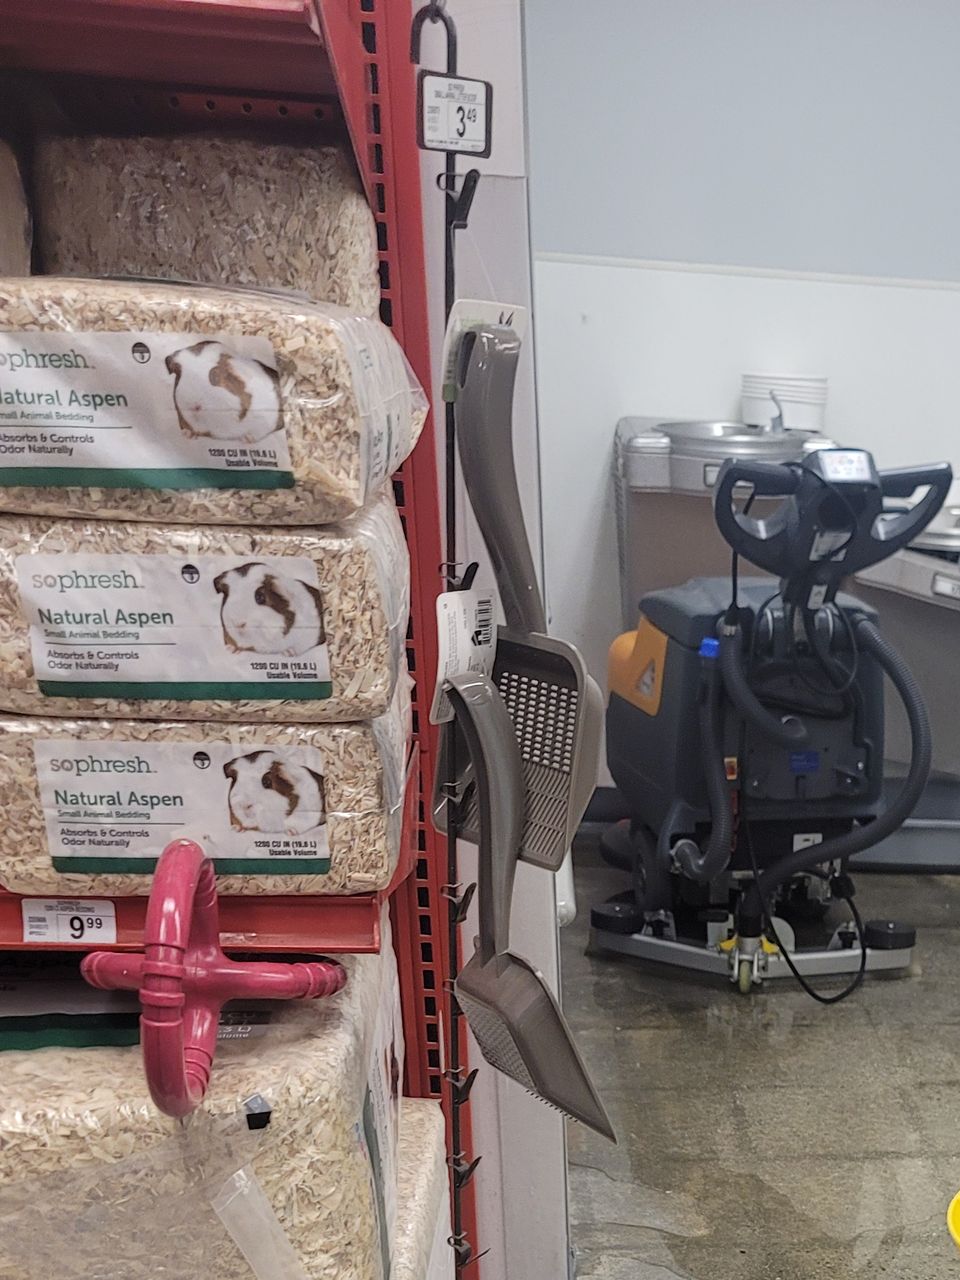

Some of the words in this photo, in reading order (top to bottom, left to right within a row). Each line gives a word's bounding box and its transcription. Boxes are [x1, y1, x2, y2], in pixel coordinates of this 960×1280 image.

[0, 349, 89, 372] ophresh
[0, 389, 63, 406] atural
[68, 389, 129, 411] Aspen
[0, 411, 18, 419] mall
[20, 411, 53, 420] Animal
[55, 412, 95, 423] Bedding
[0, 433, 38, 442] bsorbs
[40, 433, 47, 442] &
[49, 434, 95, 443] Controls
[0, 445, 26, 454] Odor
[28, 445, 74, 456] Naturally
[32, 570, 138, 593] sophresh
[37, 608, 110, 625] Natural
[115, 608, 175, 628] Aspen
[44, 629, 67, 639] Small
[68, 631, 101, 639] Animal
[102, 631, 140, 640] Bedding
[47, 650, 85, 660] Absorbs
[87, 651, 95, 660] &
[96, 651, 140, 660] Controls
[47, 660, 73, 670] Odor
[75, 661, 119, 672] Naturally
[269, 662, 280, 671] CU
[266, 671, 291, 680] Usable
[292, 672, 318, 680] Volume
[50, 755, 151, 776] sophresh
[54, 790, 122, 806] Natural
[127, 791, 184, 809] Aspen
[57, 809, 82, 818] Small
[83, 810, 113, 819] Animal
[115, 811, 151, 820] Bedding
[60, 828, 98, 837] Absorbs
[100, 828, 107, 837] &
[109, 829, 150, 838] Controls
[61, 837, 86, 847] Odor
[88, 838, 130, 849] Naturally
[272, 840, 281, 848] CU
